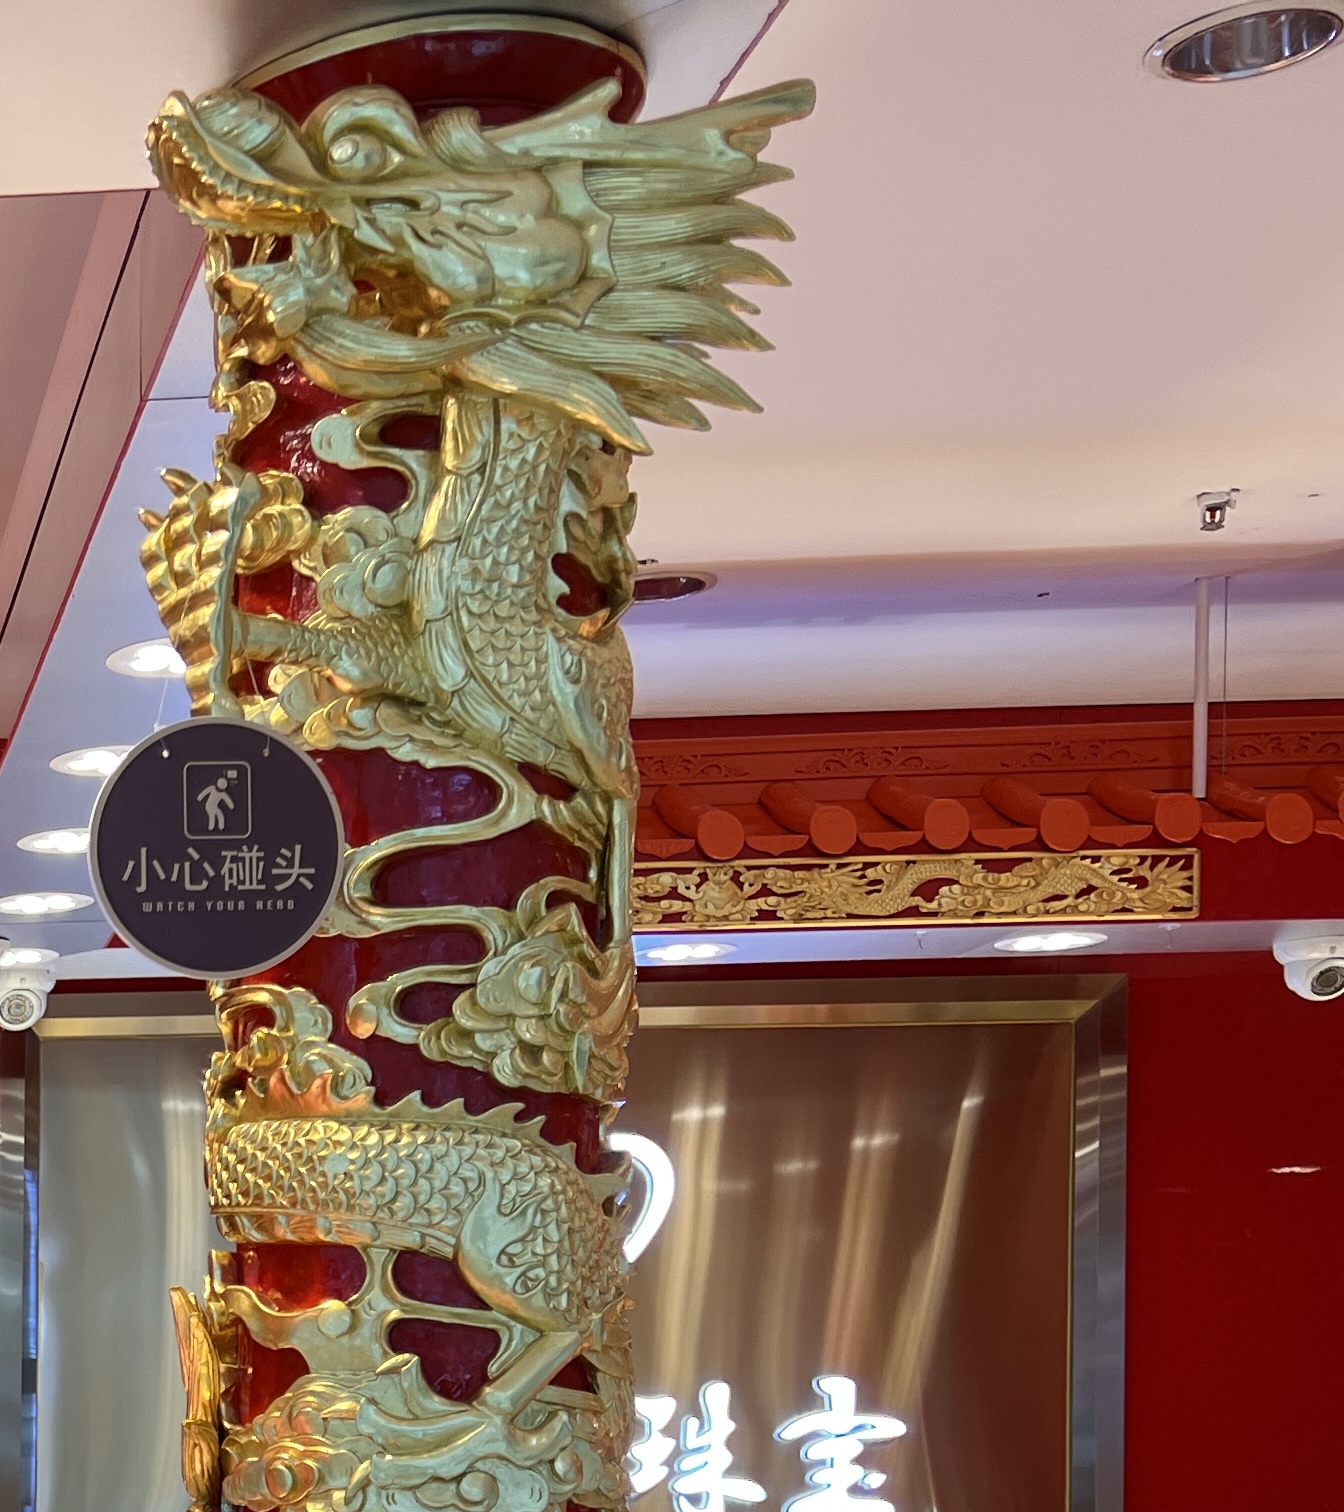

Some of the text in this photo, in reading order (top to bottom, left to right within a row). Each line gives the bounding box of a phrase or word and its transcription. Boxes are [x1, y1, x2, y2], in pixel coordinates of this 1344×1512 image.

[121, 844, 316, 893] 小心碰头
[142, 899, 295, 912] WATCH YOUR HEAD
